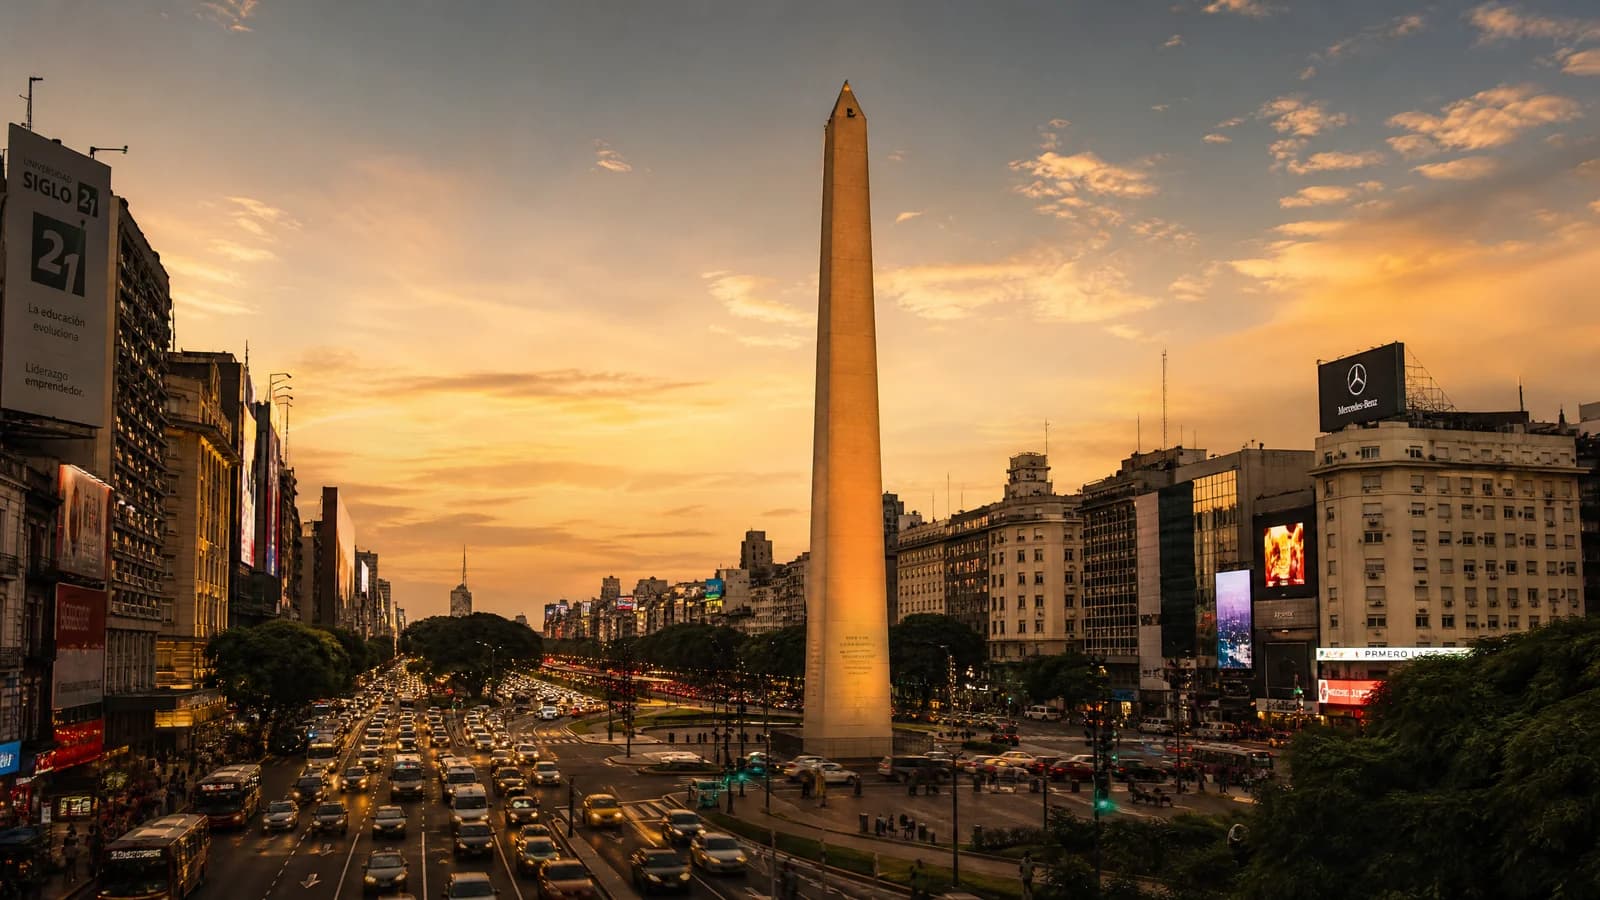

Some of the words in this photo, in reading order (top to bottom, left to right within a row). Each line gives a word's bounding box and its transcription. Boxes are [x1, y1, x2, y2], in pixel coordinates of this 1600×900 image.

[23, 171, 72, 204] SIGLO
[78, 188, 97, 216] 21
[37, 228, 81, 295] 21
[28, 303, 39, 314] La
[40, 308, 86, 329] educación
[33, 322, 79, 342] evoluciona
[25, 362, 69, 382] Liderazgo
[24, 377, 85, 397] emprendedor.
[1338, 398, 1378, 416] Mercedes-Benz
